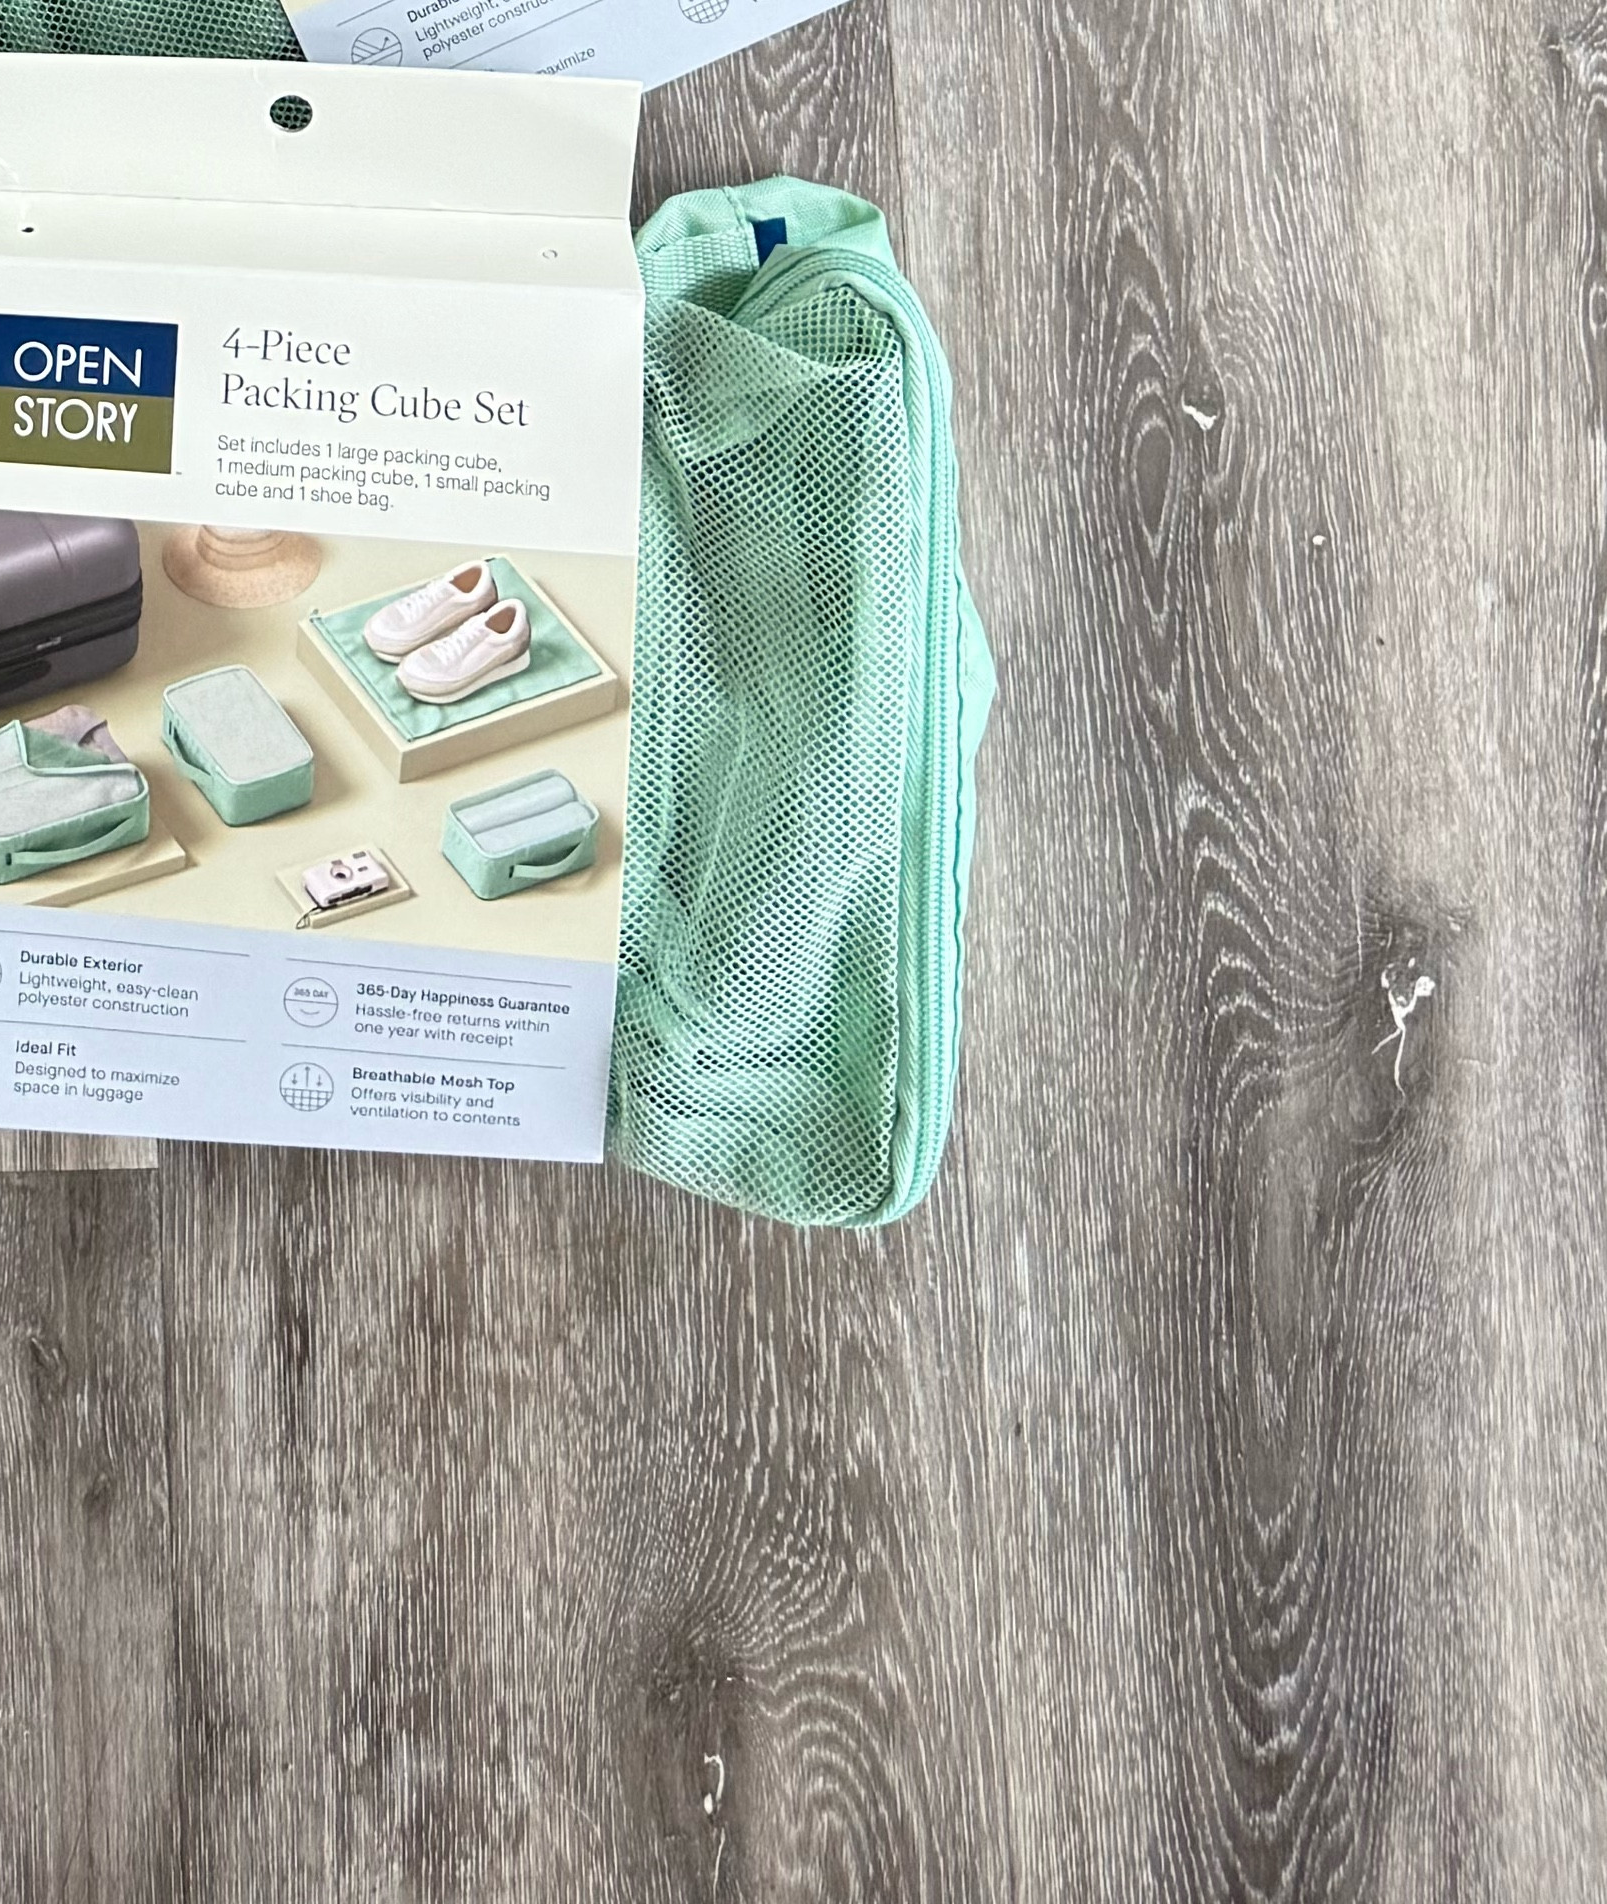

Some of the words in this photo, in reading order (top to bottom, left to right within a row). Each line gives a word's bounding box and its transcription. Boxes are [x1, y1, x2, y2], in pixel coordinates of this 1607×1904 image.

[422, 22, 484, 61] polyester
[222, 327, 350, 366] 4-Piece
[14, 341, 142, 387] OPEN
[221, 372, 359, 423] Packing
[370, 383, 461, 421] Cube
[474, 390, 529, 426] Set
[14, 395, 138, 442] STORY
[217, 434, 245, 452] Set
[250, 436, 320, 457] includes
[326, 443, 331, 458] 1
[337, 442, 378, 465] large
[383, 448, 449, 471] packing
[454, 453, 501, 472] cube,
[217, 457, 222, 472] 1
[228, 459, 294, 477] medium
[300, 465, 366, 487] packing
[371, 469, 418, 488] cube,
[424, 473, 430, 488] 1
[436, 475, 478, 491] small
[483, 479, 550, 501] packing
[215, 480, 258, 497] cube
[263, 484, 293, 500] and
[299, 486, 305, 501] 1
[310, 486, 352, 504] shoe
[358, 488, 393, 511] bag.
[20, 950, 78, 967] Durable
[83, 955, 143, 973] Exterior
[19, 971, 111, 994] Lightweight,
[116, 982, 198, 1001] easy-clean
[356, 982, 417, 1003] 365-Day
[421, 989, 494, 1008] Happiness
[498, 996, 570, 1014] Guarantee
[18, 990, 88, 1008] polyester
[92, 998, 188, 1017] construction
[355, 1003, 442, 1023] Hassle-free
[447, 1014, 500, 1028] returns
[504, 1018, 549, 1032] within
[15, 1040, 52, 1055] Ideal
[57, 1042, 76, 1056] Fit
[354, 1022, 384, 1034] one
[388, 1026, 420, 1039] year
[424, 1028, 455, 1041] with
[460, 1032, 513, 1048] receipt
[15, 1060, 86, 1080] Designed
[91, 1067, 106, 1080] to
[110, 1070, 180, 1086] maximize
[352, 1066, 435, 1085] Breathable
[440, 1074, 483, 1088] Mesh
[486, 1077, 514, 1094] Top
[13, 1081, 59, 1096] space
[64, 1082, 77, 1095] in
[82, 1083, 143, 1104] luggage
[351, 1086, 396, 1102] Offers
[400, 1091, 461, 1109] visibility
[465, 1097, 494, 1108] and
[350, 1105, 428, 1120] ventilation
[433, 1110, 448, 1121] to
[452, 1113, 520, 1126] contents
